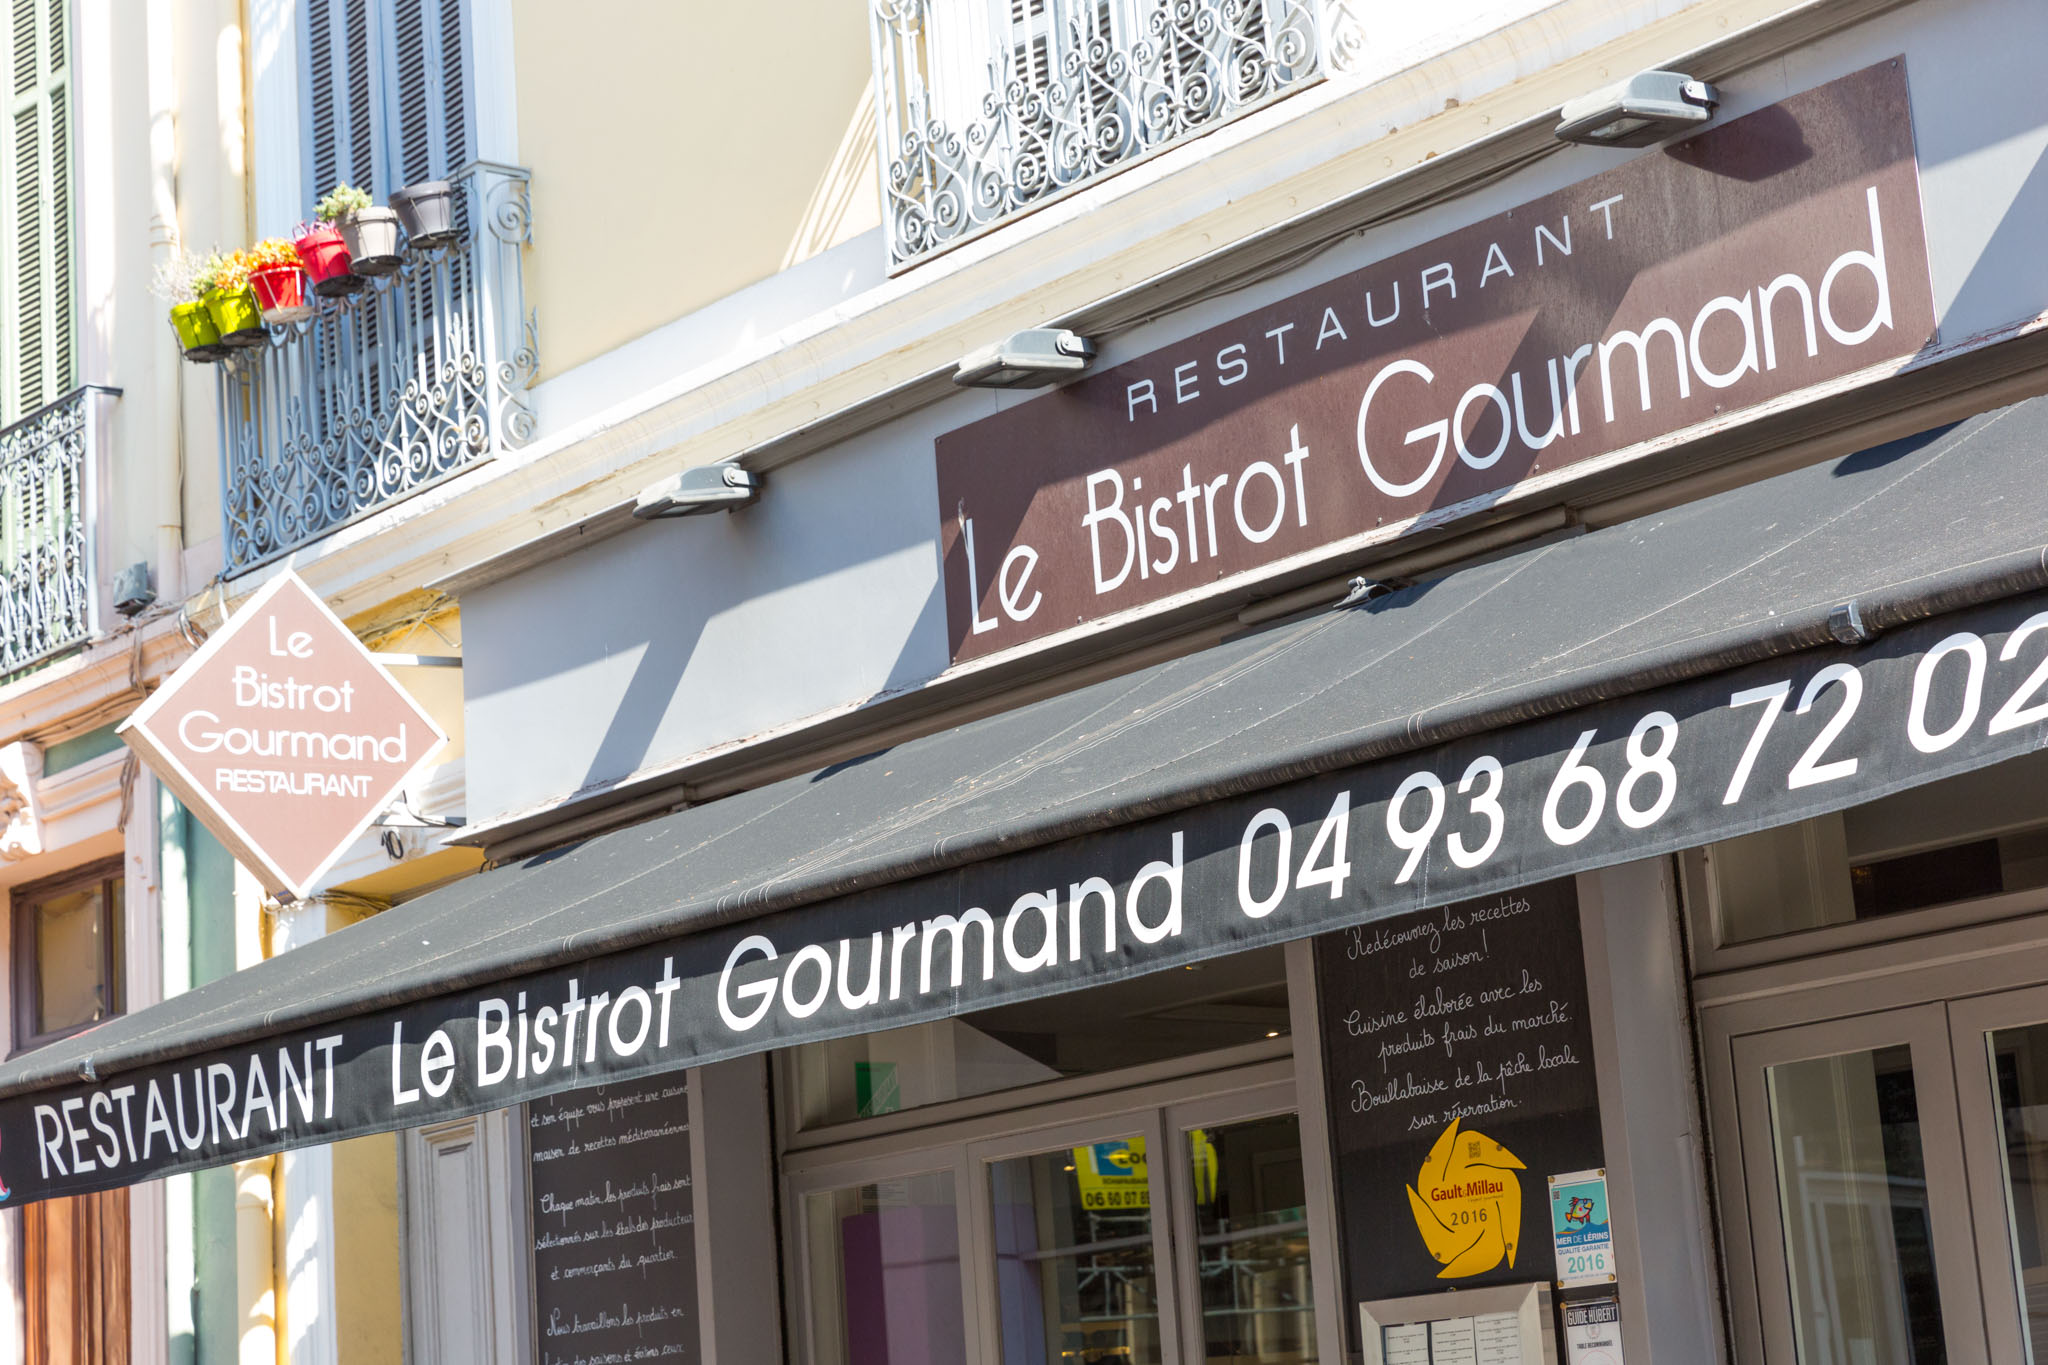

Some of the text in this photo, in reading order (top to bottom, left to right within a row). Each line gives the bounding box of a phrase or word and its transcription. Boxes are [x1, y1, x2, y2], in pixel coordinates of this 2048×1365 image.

[1127, 194, 1625, 423] RESTAURANT
[963, 186, 1894, 635] Le Bistrot Gourmand
[269, 615, 313, 658] Le
[232, 665, 354, 713] Bistrot
[178, 710, 406, 763] Gourmand
[216, 768, 373, 798] RESTAURANT
[34, 611, 2048, 1180] RESTAURANT Le Bistrot Gourmand 04 93 68 72 02
[1442, 905, 1465, 932] les
[1469, 896, 1530, 925] recettes
[1409, 957, 1426, 978] de
[1343, 969, 1543, 1036] Cuisine élaborée avec les
[1378, 1028, 1435, 1074] produits
[1441, 1022, 1477, 1058] frais
[1484, 1015, 1506, 1036] du
[1351, 1045, 1579, 1113] Bouillabaisse de la pêche locale
[1408, 1113, 1437, 1131] sur
[568, 1139, 581, 1156] de
[540, 1193, 575, 1227] Chaque
[604, 1180, 617, 1203] les
[1451, 1208, 1487, 1226] 2016
[582, 1231, 600, 1242] sur
[601, 1220, 614, 1238] les
[1556, 1236, 1572, 1245] MER
[1573, 1235, 1582, 1244] DE
[1568, 1253, 1605, 1273] 2016
[1582, 1243, 1609, 1253] GARANTIE
[551, 1265, 560, 1280] et
[618, 1253, 632, 1270] du
[621, 1303, 635, 1326] les
[1567, 1310, 1588, 1325] GUIDE
[1588, 1307, 1616, 1323] HUBERT
